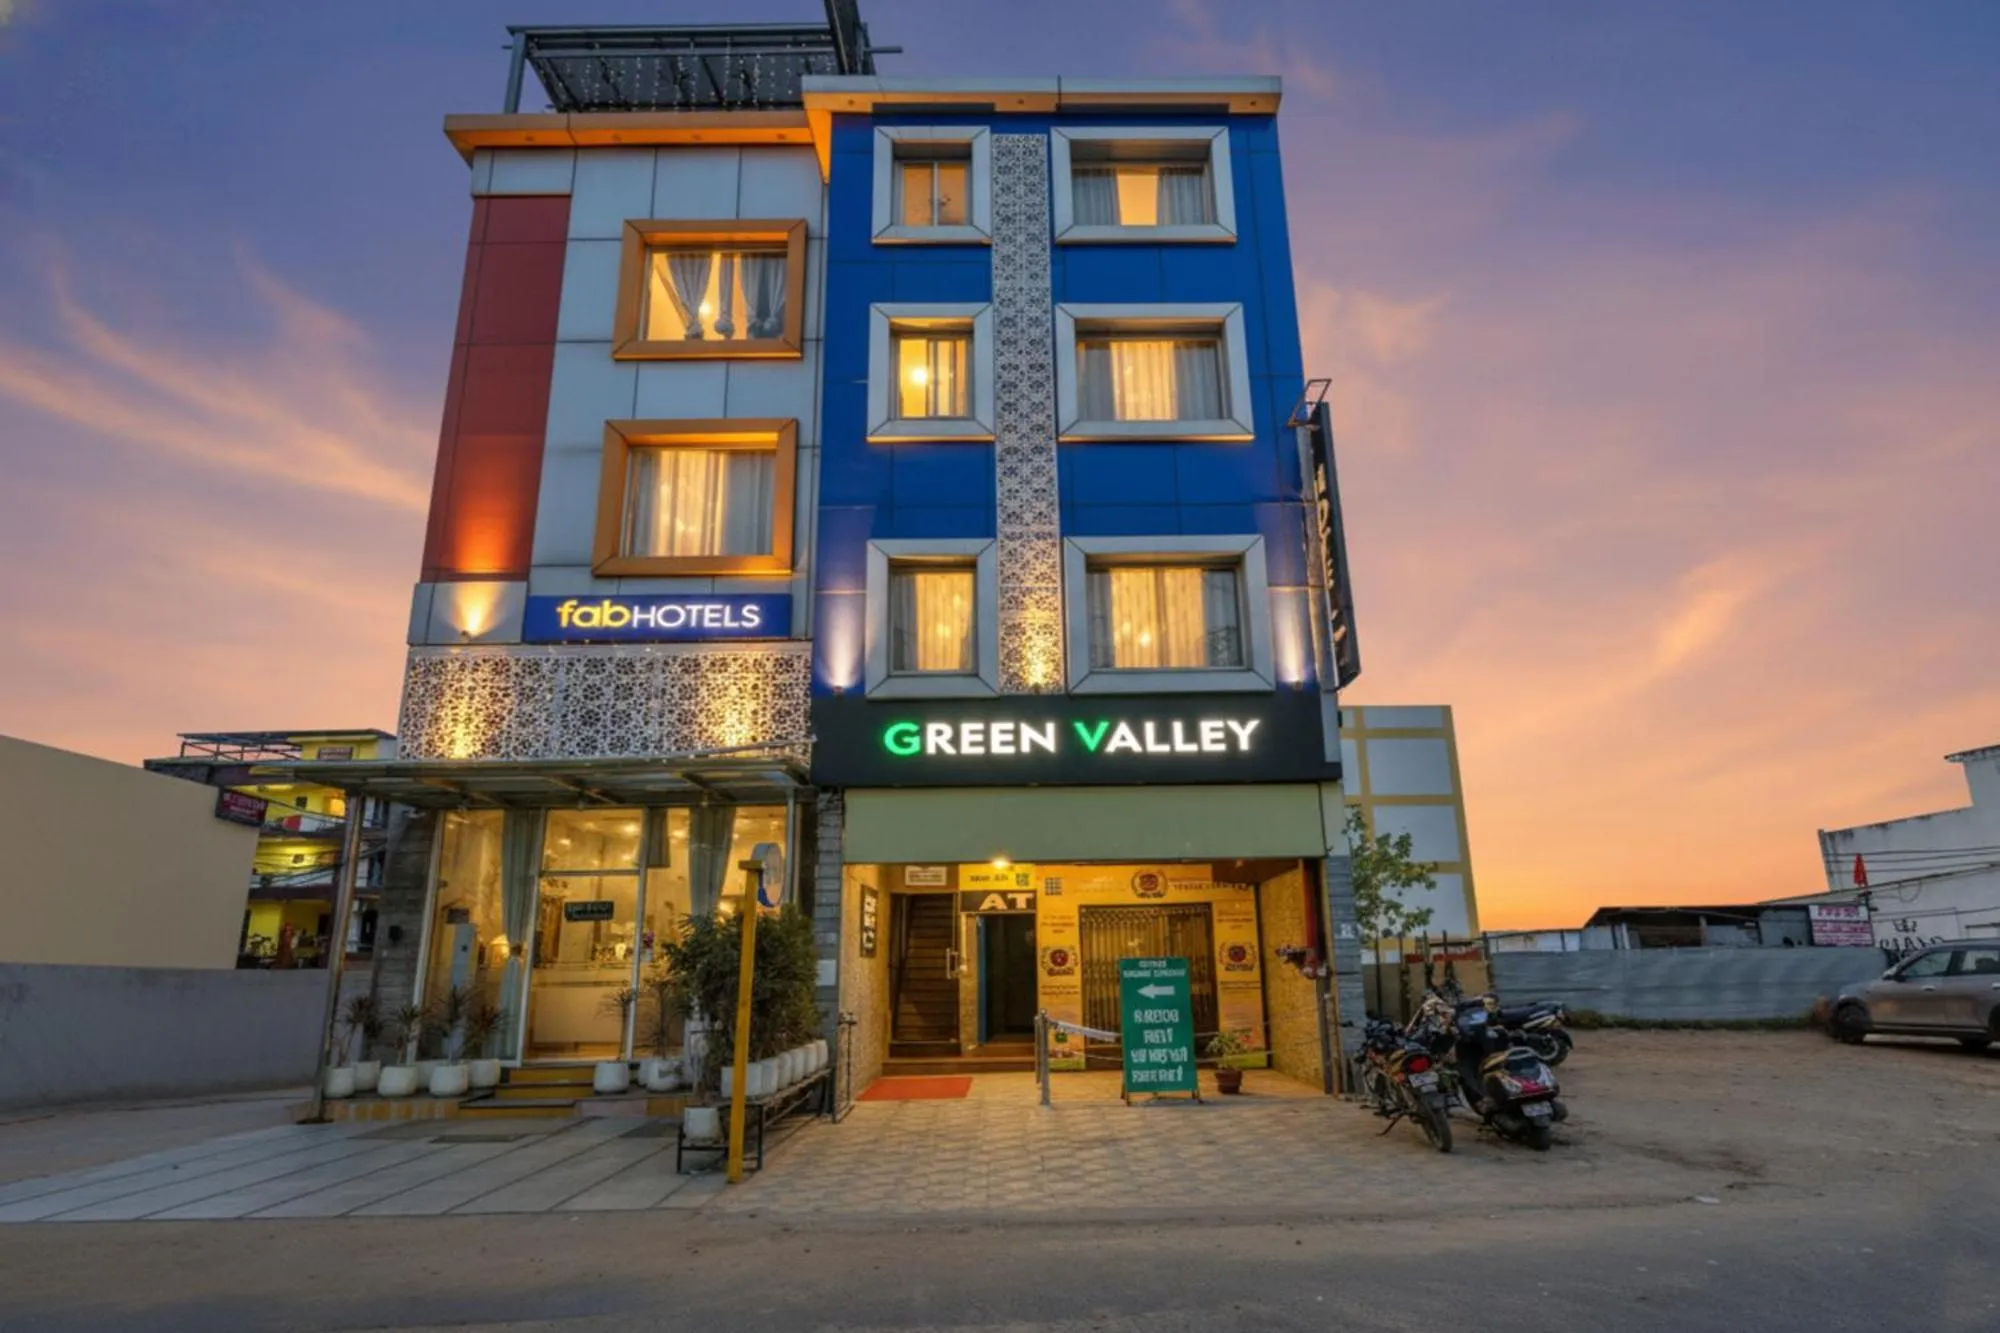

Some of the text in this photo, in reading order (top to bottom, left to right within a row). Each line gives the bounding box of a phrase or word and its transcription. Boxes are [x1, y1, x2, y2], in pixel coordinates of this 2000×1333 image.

[556, 599, 761, 628] fabHOTELS
[883, 719, 1261, 755] GREEN VALLEY
